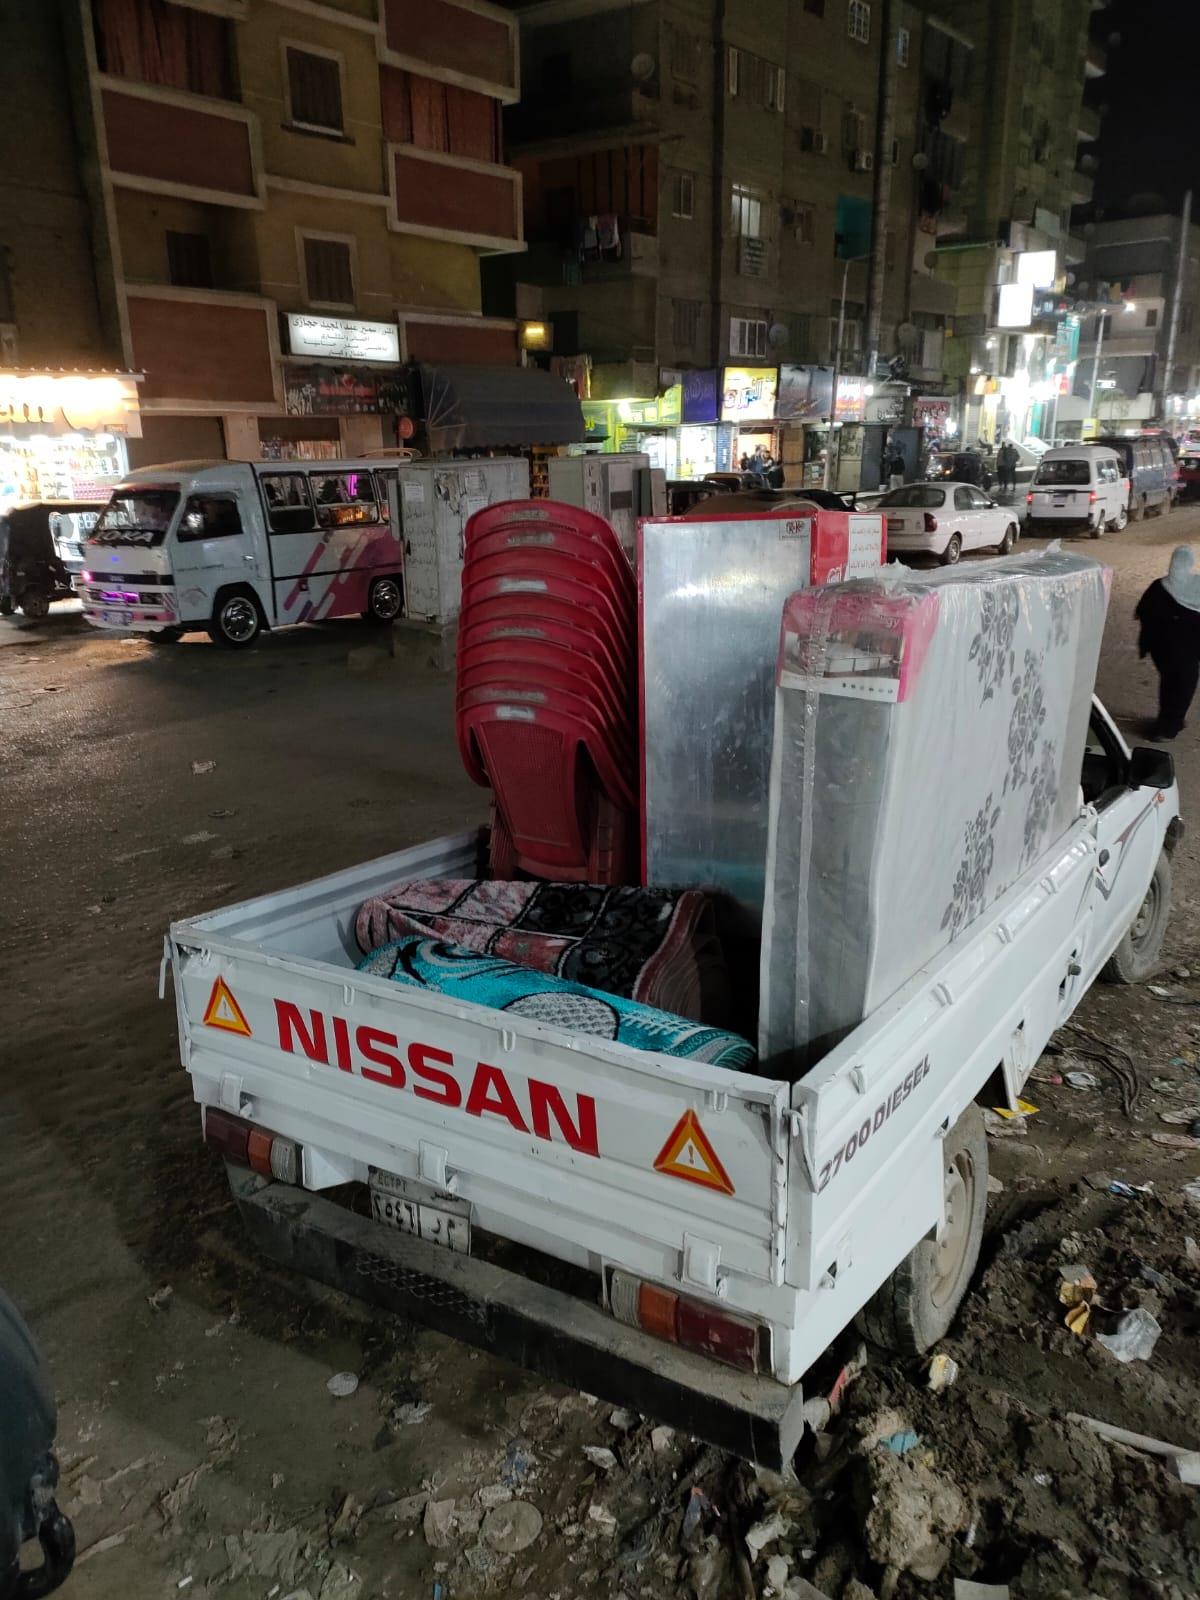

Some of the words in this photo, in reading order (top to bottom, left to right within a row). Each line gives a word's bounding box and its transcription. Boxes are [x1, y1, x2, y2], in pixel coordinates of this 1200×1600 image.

[273, 998, 601, 1159] NISSAN
[816, 1117, 872, 1196] 2700
[873, 1053, 931, 1135] DIESEL
